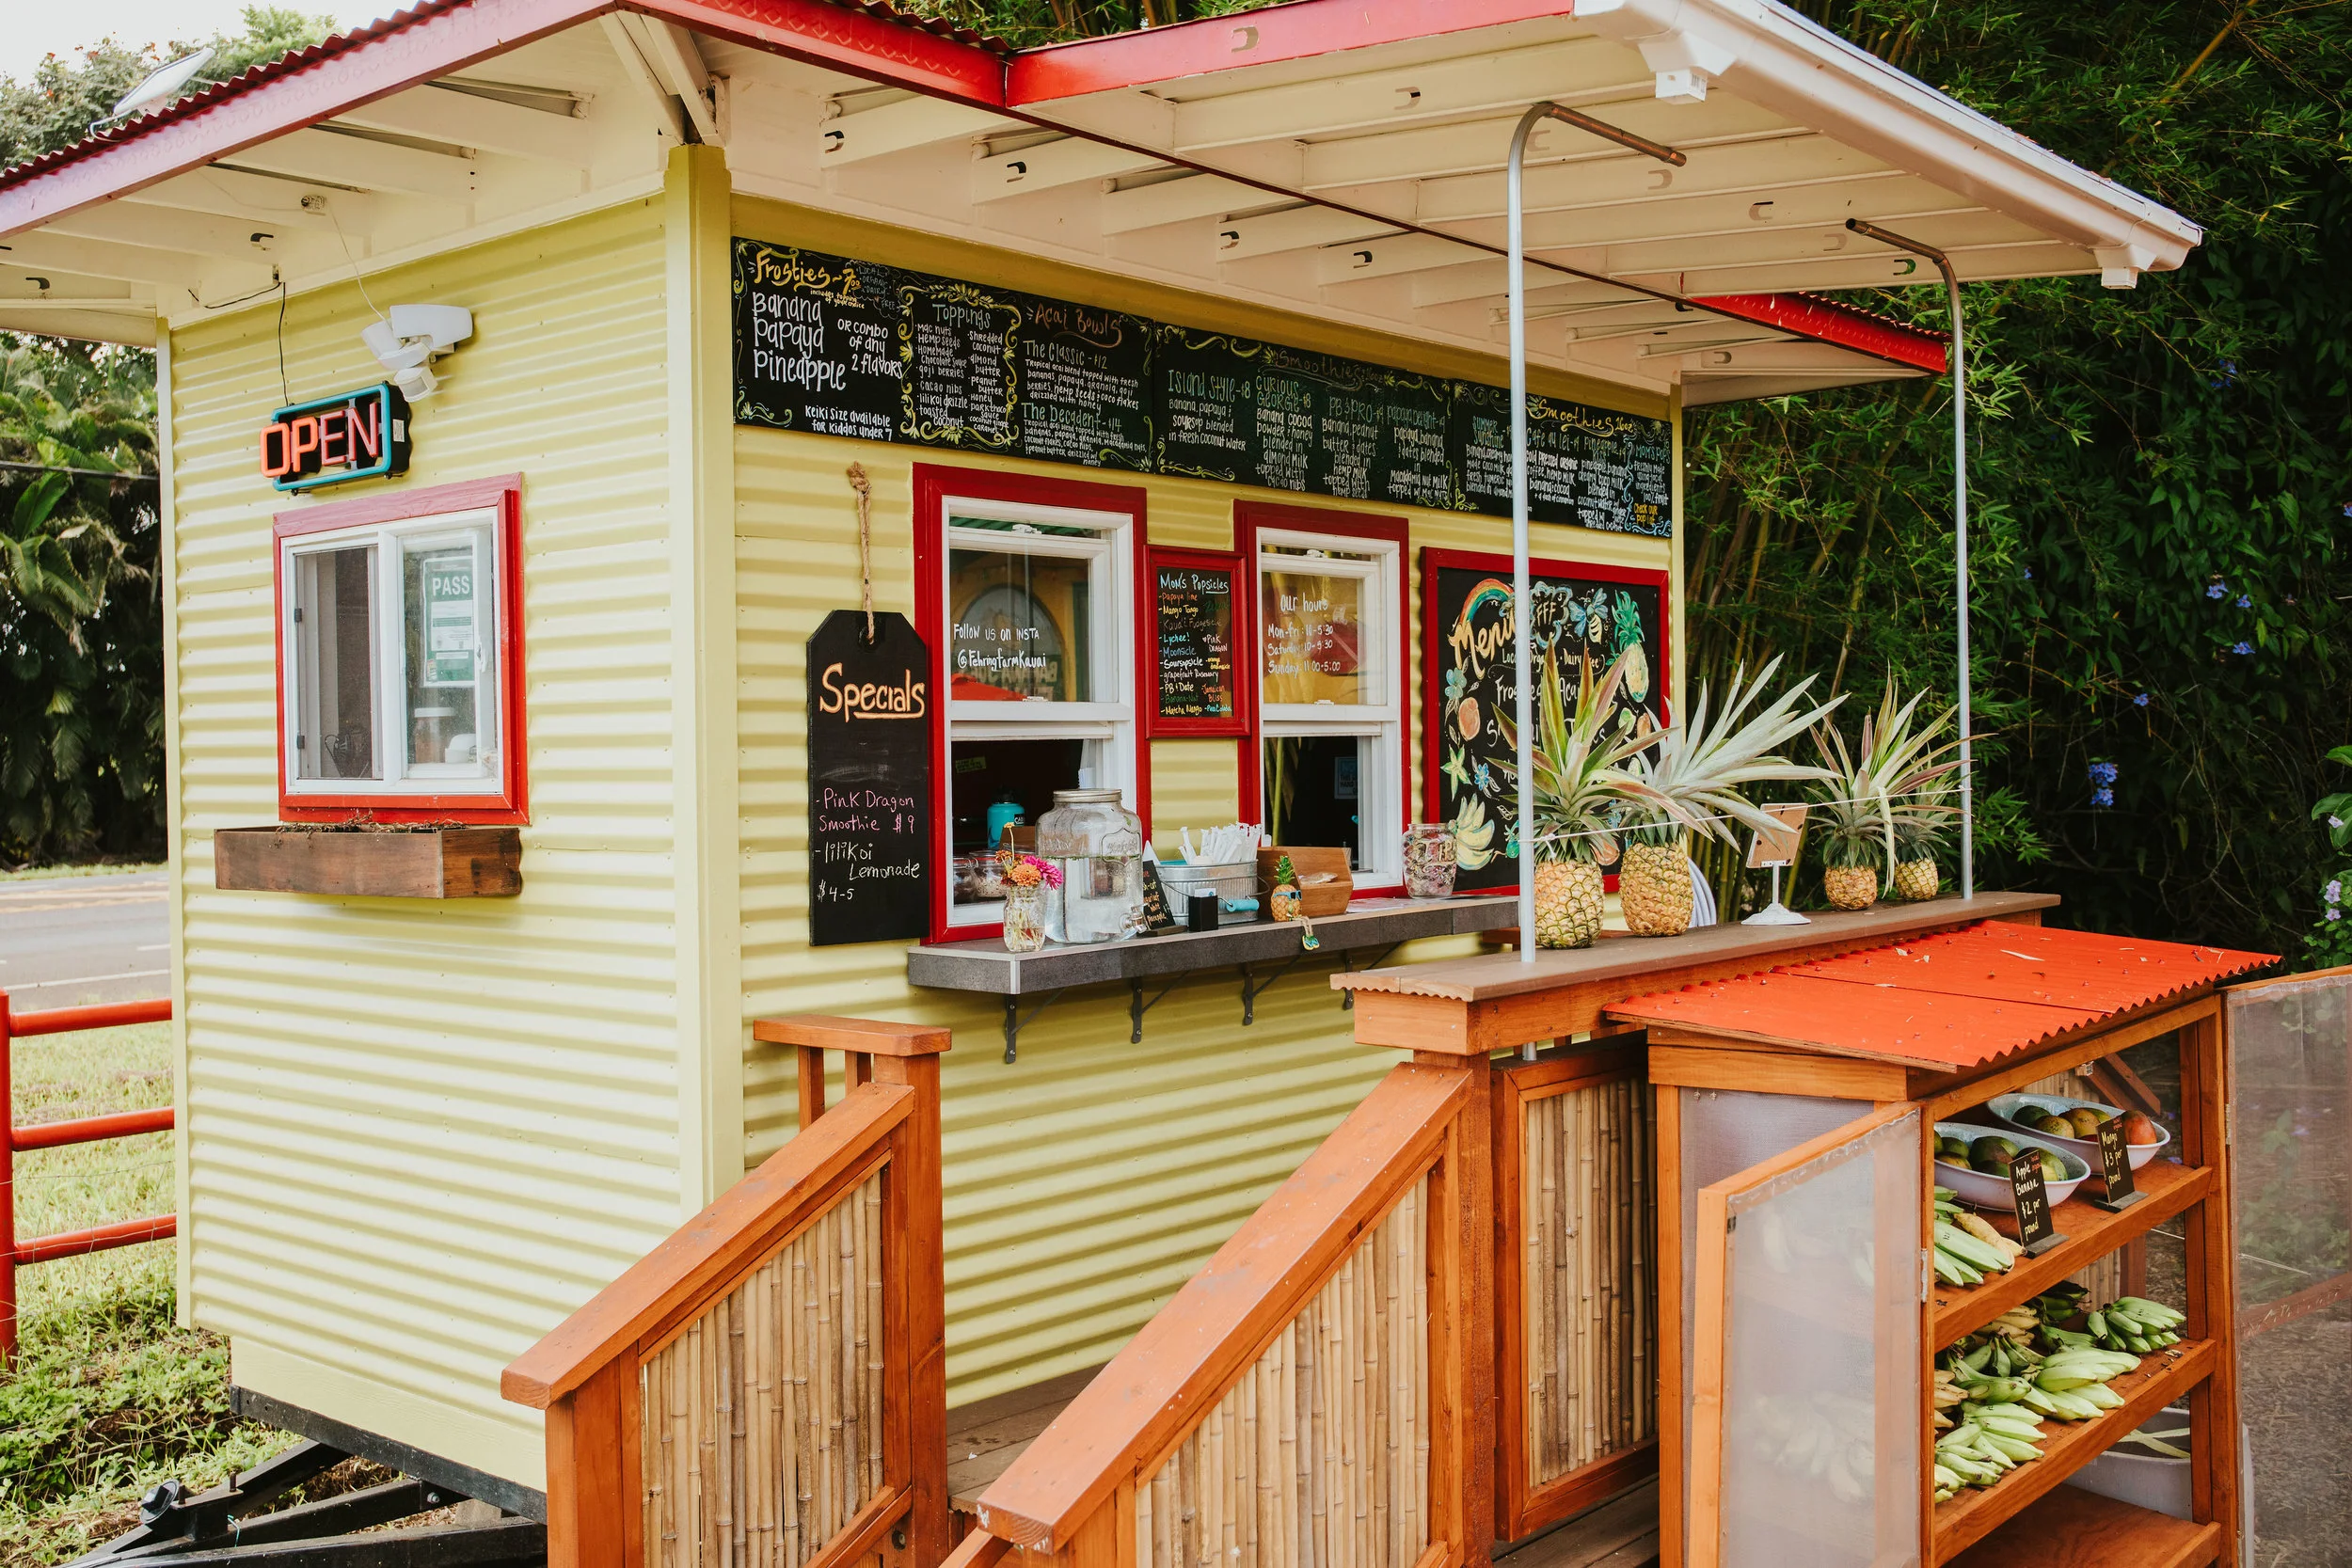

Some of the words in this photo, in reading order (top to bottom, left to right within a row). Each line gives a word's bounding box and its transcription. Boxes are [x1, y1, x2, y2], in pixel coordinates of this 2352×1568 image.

[755, 247, 831, 292] Frosties
[753, 292, 822, 326] Banana
[932, 303, 991, 330] Toppings
[1036, 302, 1069, 330] Acai
[1073, 308, 1121, 340] Bowls
[935, 325, 951, 336] nuts
[850, 336, 862, 351] of
[866, 338, 885, 361] any
[942, 336, 960, 350] seeds
[973, 342, 1001, 355] coconut
[1023, 340, 1045, 358] The
[1049, 342, 1085, 366] Classic
[851, 354, 858, 371] 2
[1275, 350, 1362, 389] Smoothies
[918, 365, 934, 379] goji
[1025, 358, 1051, 371] Tropical
[1053, 363, 1064, 372] acai
[1064, 366, 1081, 376] blend
[1082, 369, 1104, 381] topped
[1104, 375, 1119, 385] with
[920, 380, 943, 392] cacao
[946, 384, 962, 395] nibs
[971, 376, 997, 387] peanut
[1168, 370, 1205, 400] Island
[1075, 388, 1096, 402] seeds
[1101, 393, 1116, 404] coco
[1117, 396, 1139, 410] flakes
[1119, 388, 1134, 399] goji
[919, 404, 948, 419] toasted
[1021, 402, 1045, 420] The
[1058, 395, 1075, 404] with
[1078, 399, 1102, 414] honey
[1199, 404, 1227, 420] papaya
[850, 410, 890, 427] available
[933, 416, 964, 429] coconut
[970, 417, 992, 425] coconut
[981, 411, 999, 420] sauce
[1257, 408, 1284, 425] Banana
[1288, 413, 1312, 429] cocoa
[1524, 399, 1614, 437] Smoothies
[885, 428, 893, 441] 7
[1205, 419, 1233, 434] blended
[1352, 423, 1378, 440] peanut
[260, 402, 378, 478] OPEN
[1168, 430, 1176, 441] in
[1200, 433, 1225, 447] coconut
[1263, 436, 1294, 451] blended
[1295, 440, 1303, 453] in
[1292, 426, 1312, 447] honey
[1356, 439, 1376, 456] dates
[1334, 451, 1360, 468] blended
[1363, 457, 1371, 468] in
[1255, 463, 1283, 480] topped
[1285, 467, 1305, 481] with
[1290, 479, 1306, 491] nibs
[432, 575, 470, 596] PASS
[1191, 574, 1230, 594] Popsicles
[1303, 593, 1328, 612] hours
[1163, 605, 1182, 619] Mango
[1183, 604, 1199, 617] Tango
[1535, 601, 1557, 626] FFF
[1000, 628, 1011, 641] on
[1164, 632, 1190, 645] Lychee!
[1163, 646, 1197, 658] Moonsicle
[1447, 607, 1516, 680] Menu
[819, 662, 926, 723] Specials
[1165, 683, 1174, 693] PB
[1179, 682, 1194, 692] Date
[866, 790, 914, 813] Dragon
[818, 815, 881, 832] Smoothie
[849, 859, 921, 880] Lemonade
[2015, 1161, 2030, 1181] Apple
[2108, 1167, 2122, 1189] pound
[2015, 1179, 2039, 1196] Banana
[2032, 1198, 2041, 1213] per
[2024, 1216, 2040, 1242] pound
